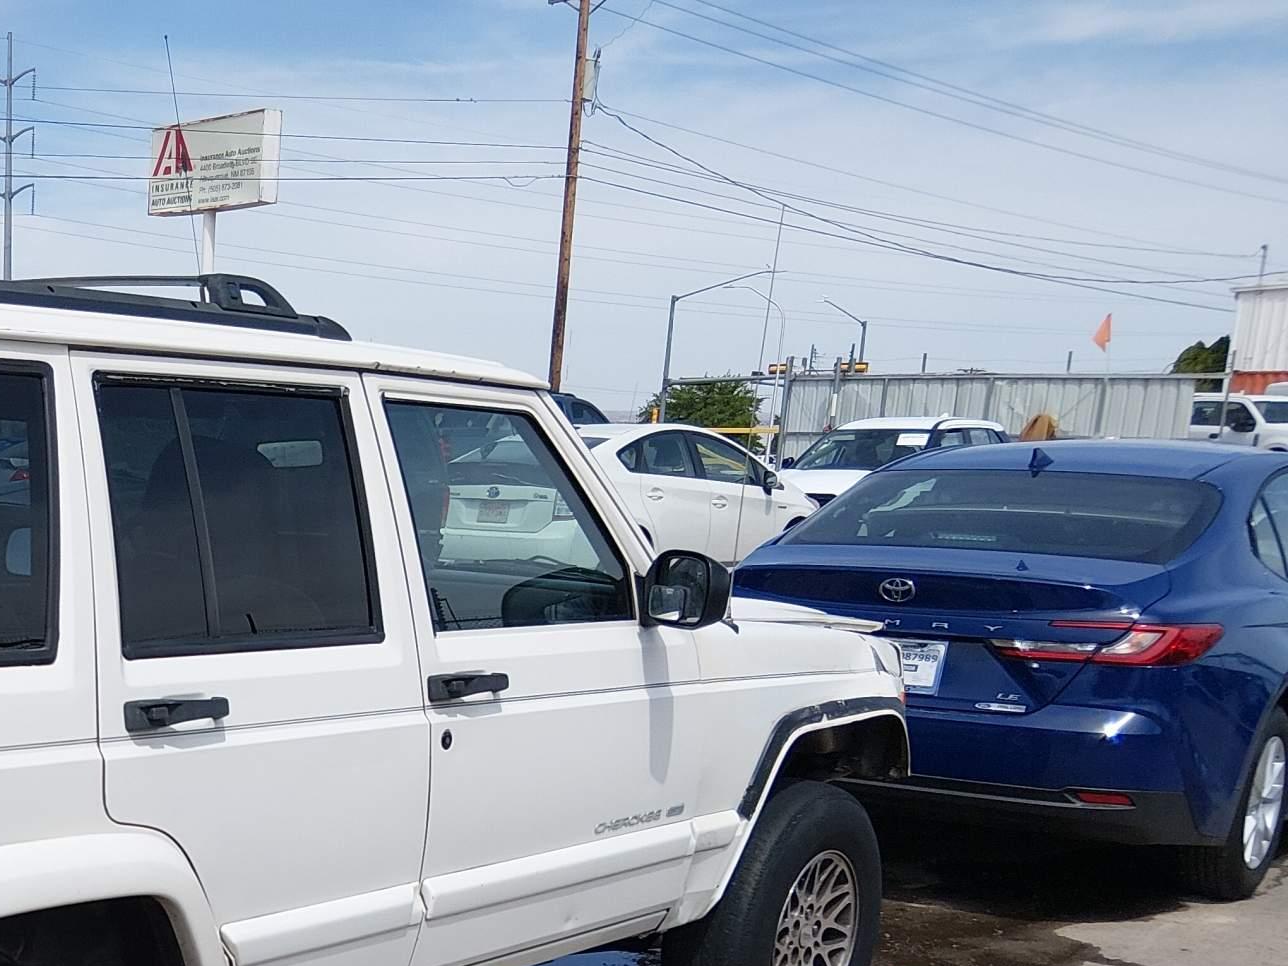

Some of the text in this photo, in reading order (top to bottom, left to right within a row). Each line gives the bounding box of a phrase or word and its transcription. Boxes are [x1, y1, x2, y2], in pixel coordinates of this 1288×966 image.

[225, 150, 237, 158] Auto
[237, 147, 261, 156] Auctions
[152, 197, 166, 207] AUTO
[884, 618, 1003, 632] MRY
[996, 693, 1023, 701] LE
[593, 808, 663, 835] CHEROKEE
